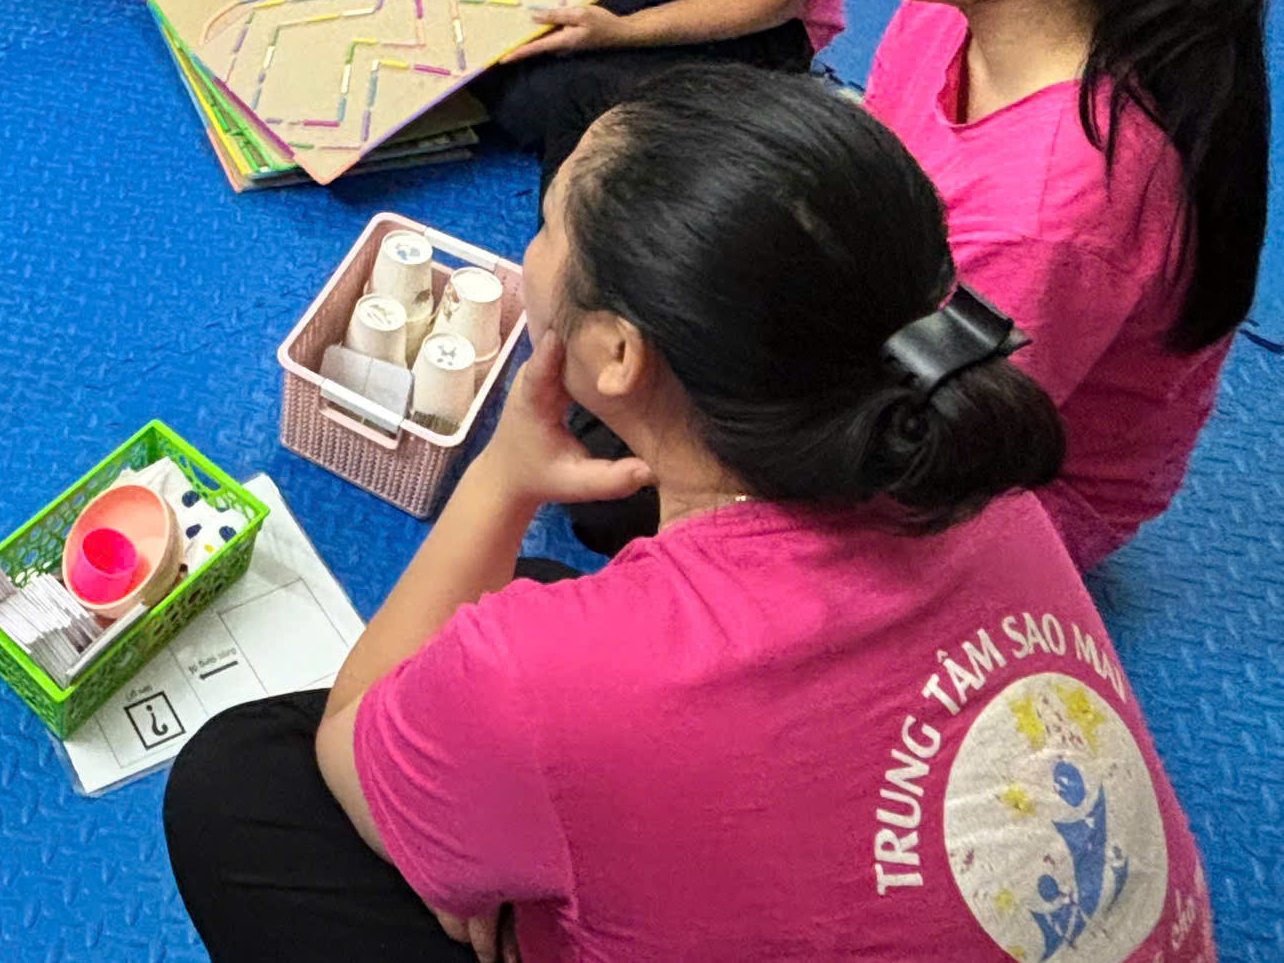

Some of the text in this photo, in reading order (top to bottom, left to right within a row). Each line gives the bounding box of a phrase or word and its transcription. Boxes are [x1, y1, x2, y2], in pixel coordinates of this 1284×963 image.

[873, 714, 941, 896] TRUNG
[921, 627, 1007, 716] TÂM
[1001, 612, 1066, 659] SAO
